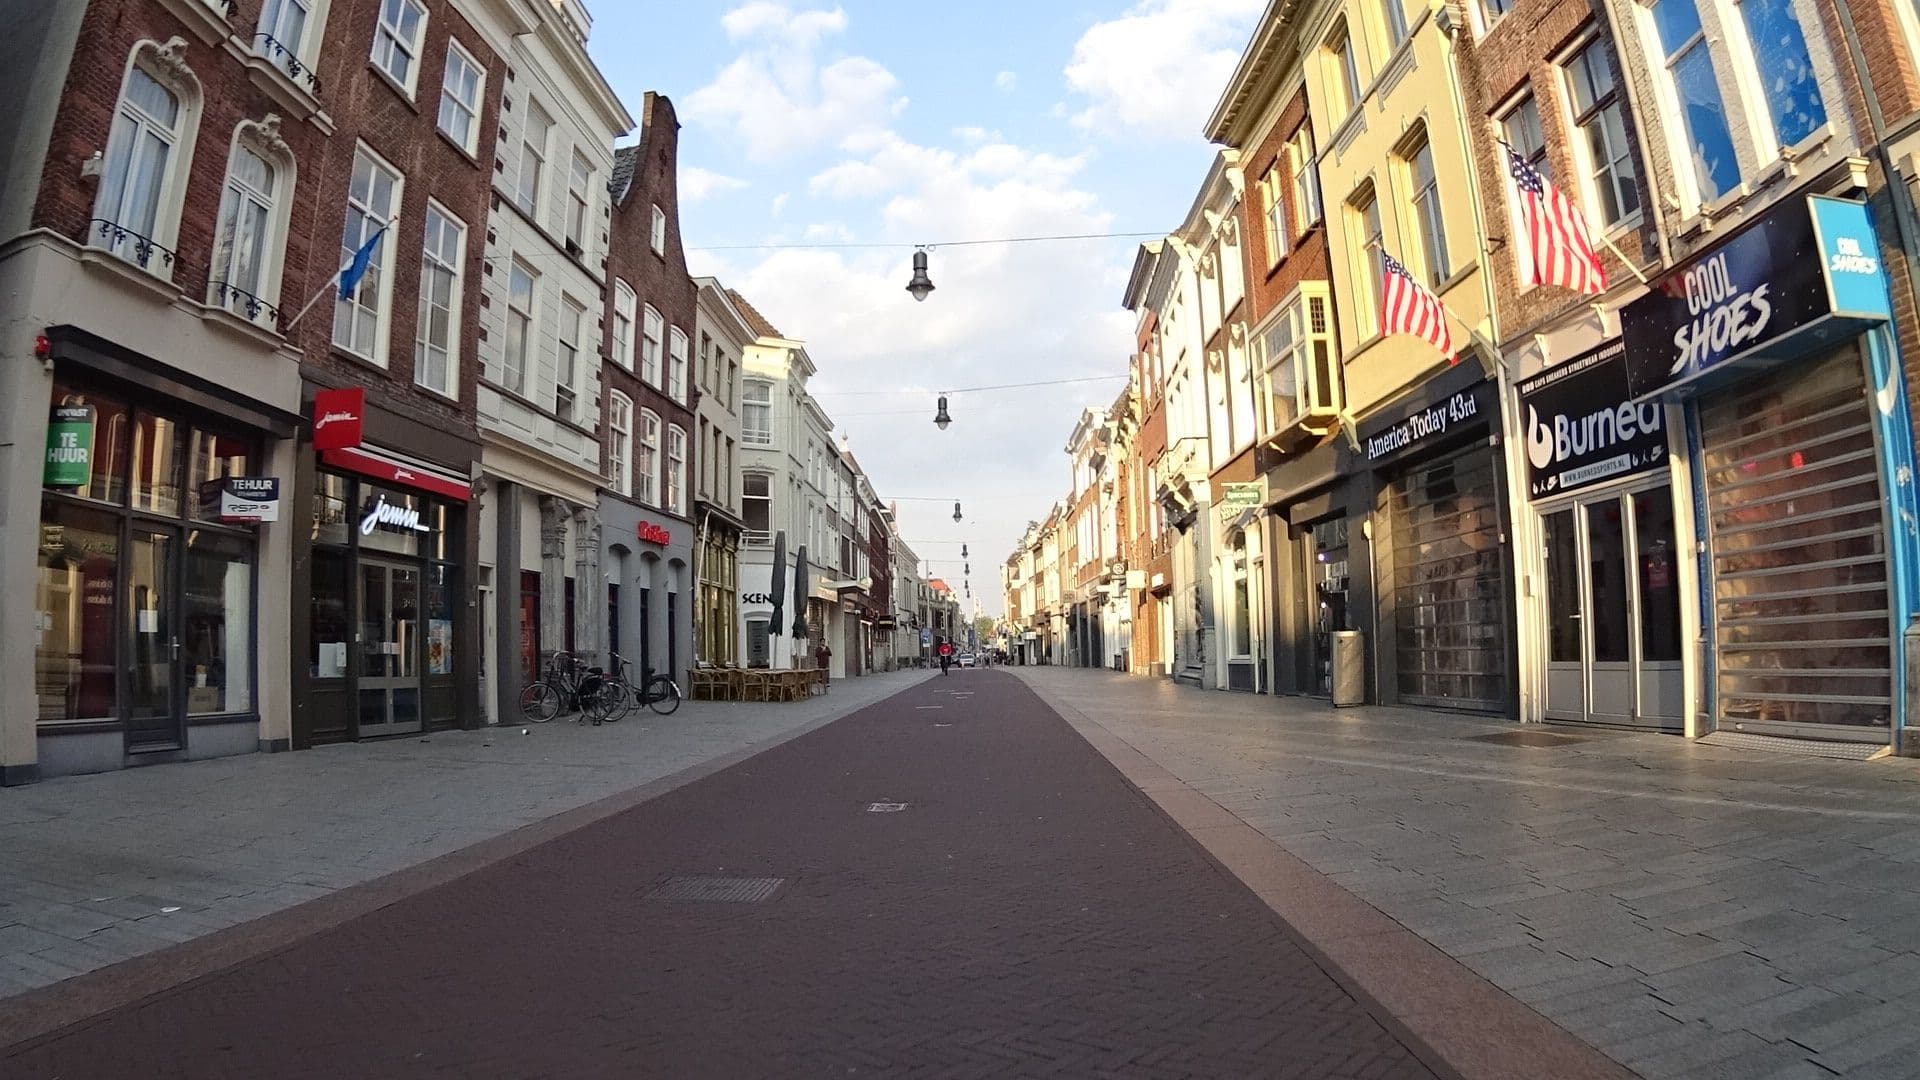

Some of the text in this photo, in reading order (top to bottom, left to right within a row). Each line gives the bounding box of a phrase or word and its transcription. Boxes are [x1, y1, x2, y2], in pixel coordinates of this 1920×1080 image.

[1836, 237, 1863, 256] COOL
[1831, 254, 1878, 274] SHOES
[1684, 252, 1737, 316] COOL
[1669, 282, 1771, 376] SHOES
[1568, 353, 1598, 374] STREETWEAR
[316, 411, 359, 430] jamin
[1368, 394, 1477, 460] America Today 43rd
[60, 432, 78, 448] TE
[47, 447, 88, 463] HUUR
[361, 494, 430, 536] jamin
